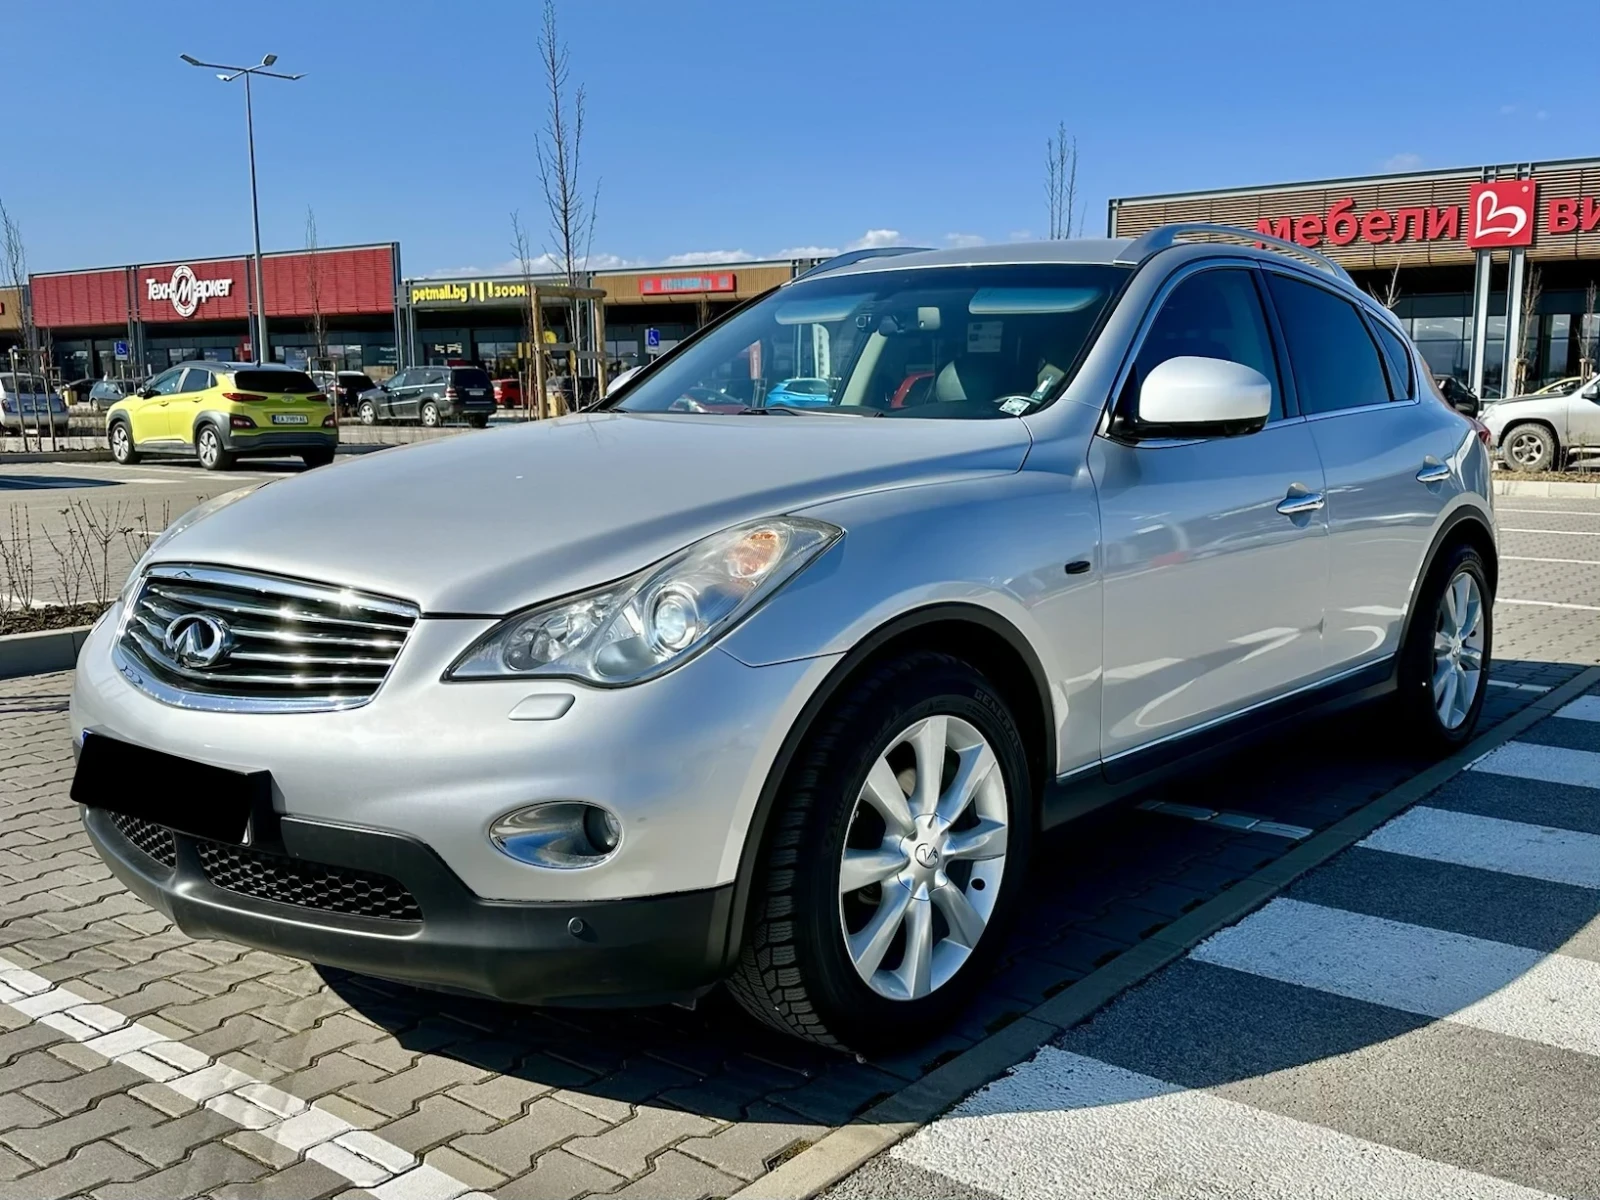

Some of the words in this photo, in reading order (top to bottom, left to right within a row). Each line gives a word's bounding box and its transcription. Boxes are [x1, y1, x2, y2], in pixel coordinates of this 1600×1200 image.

[1254, 197, 1459, 249] мебели
[412, 284, 467, 304] petmall.bg
[974, 688, 1020, 749] GENERAL
